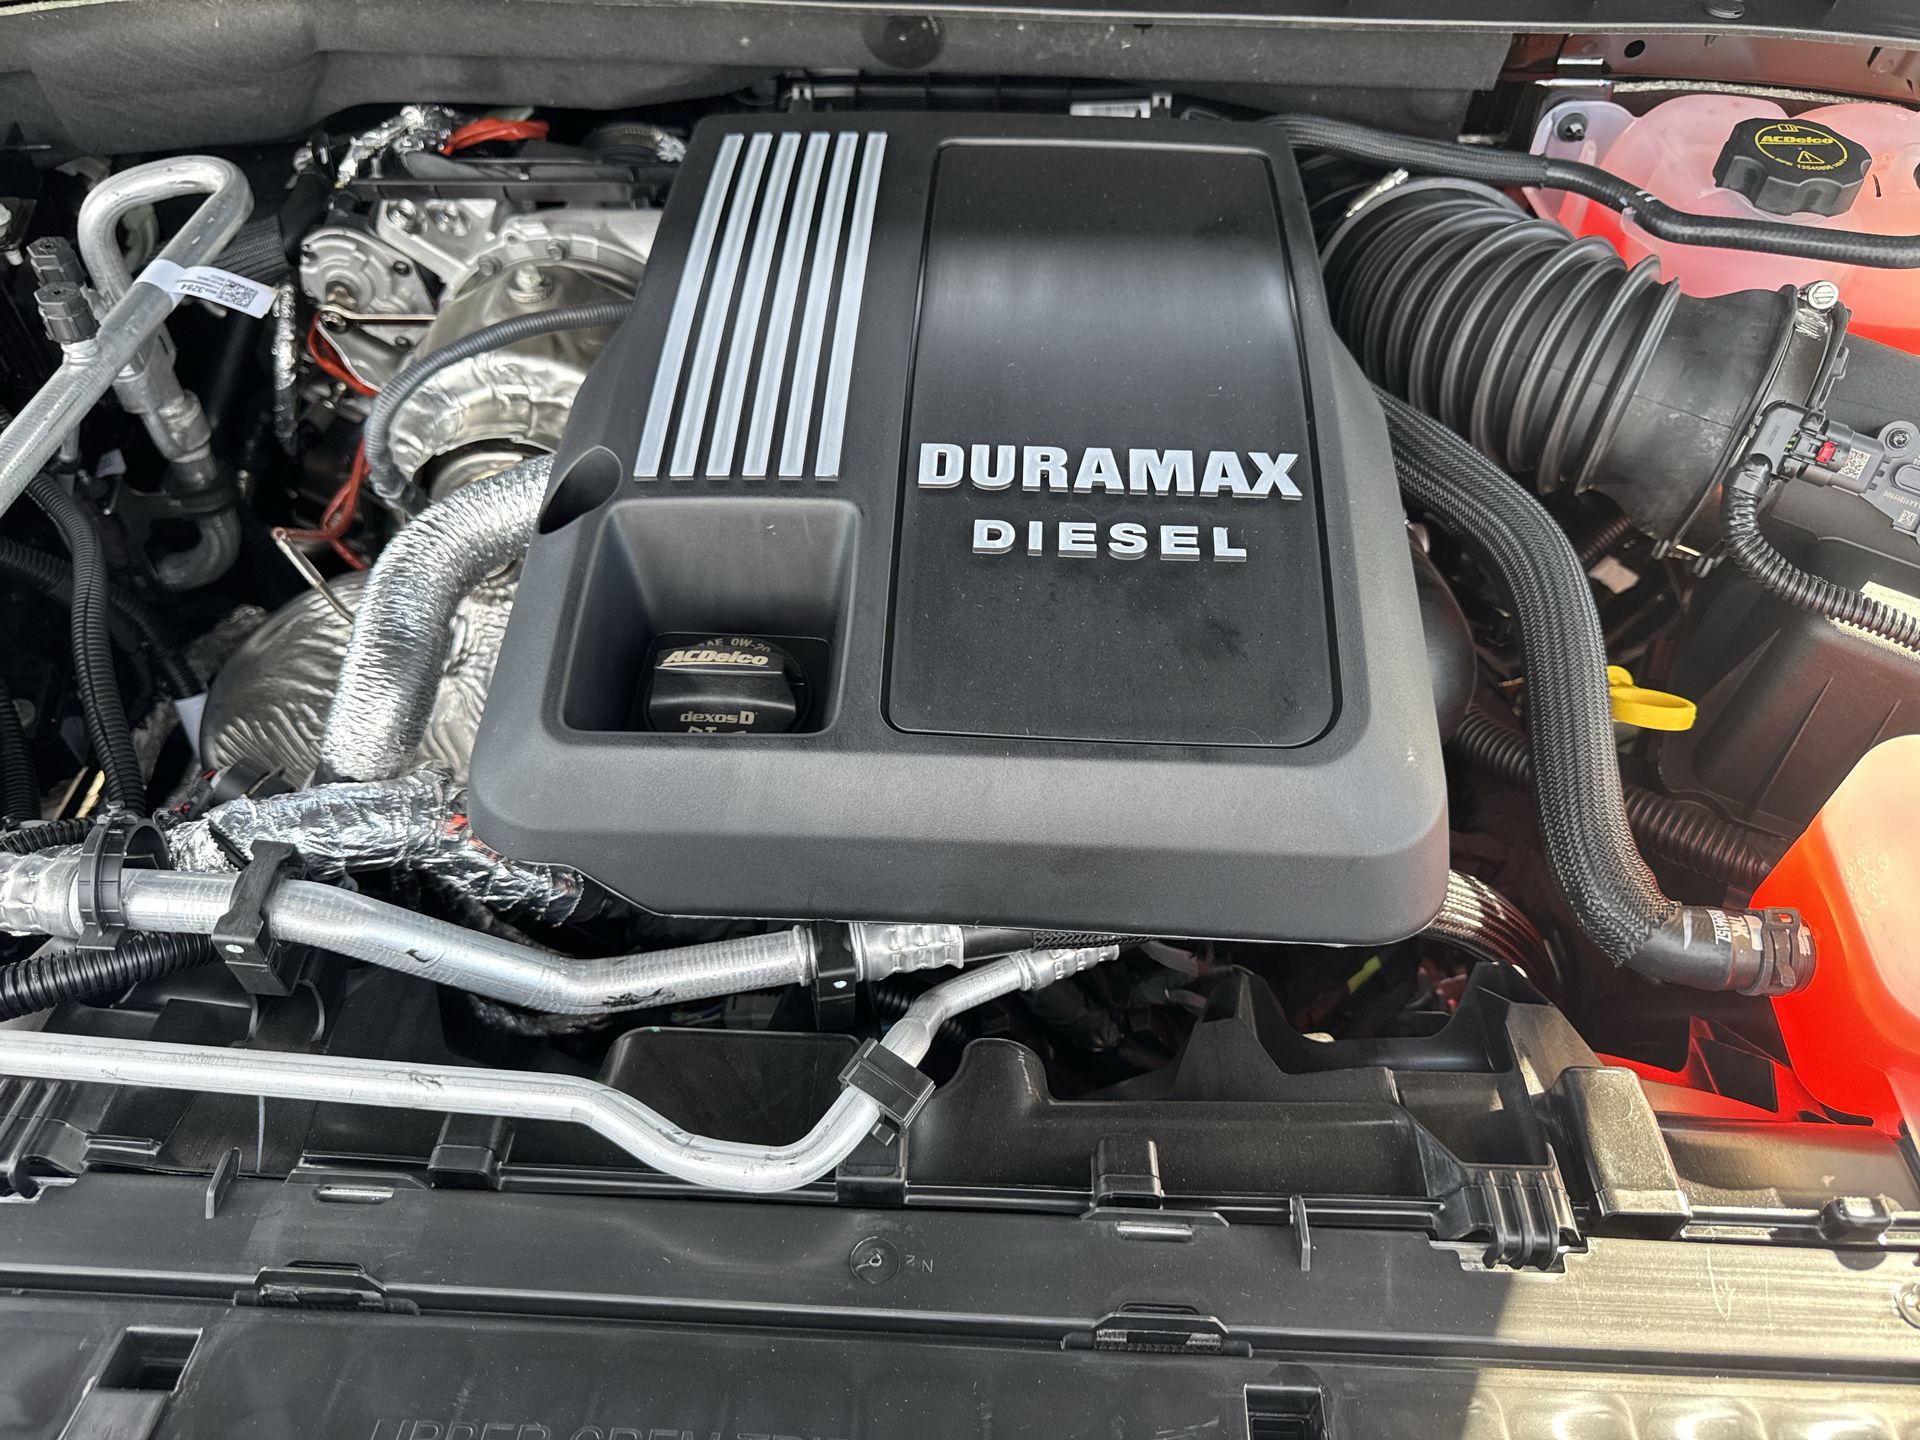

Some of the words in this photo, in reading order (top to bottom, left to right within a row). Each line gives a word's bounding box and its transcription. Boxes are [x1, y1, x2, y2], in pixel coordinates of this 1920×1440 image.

[1760, 135, 1834, 144] ACDelco
[917, 442, 1303, 500] DURAMAX
[972, 519, 1248, 562] DIESEL
[662, 650, 769, 666] ACDelco
